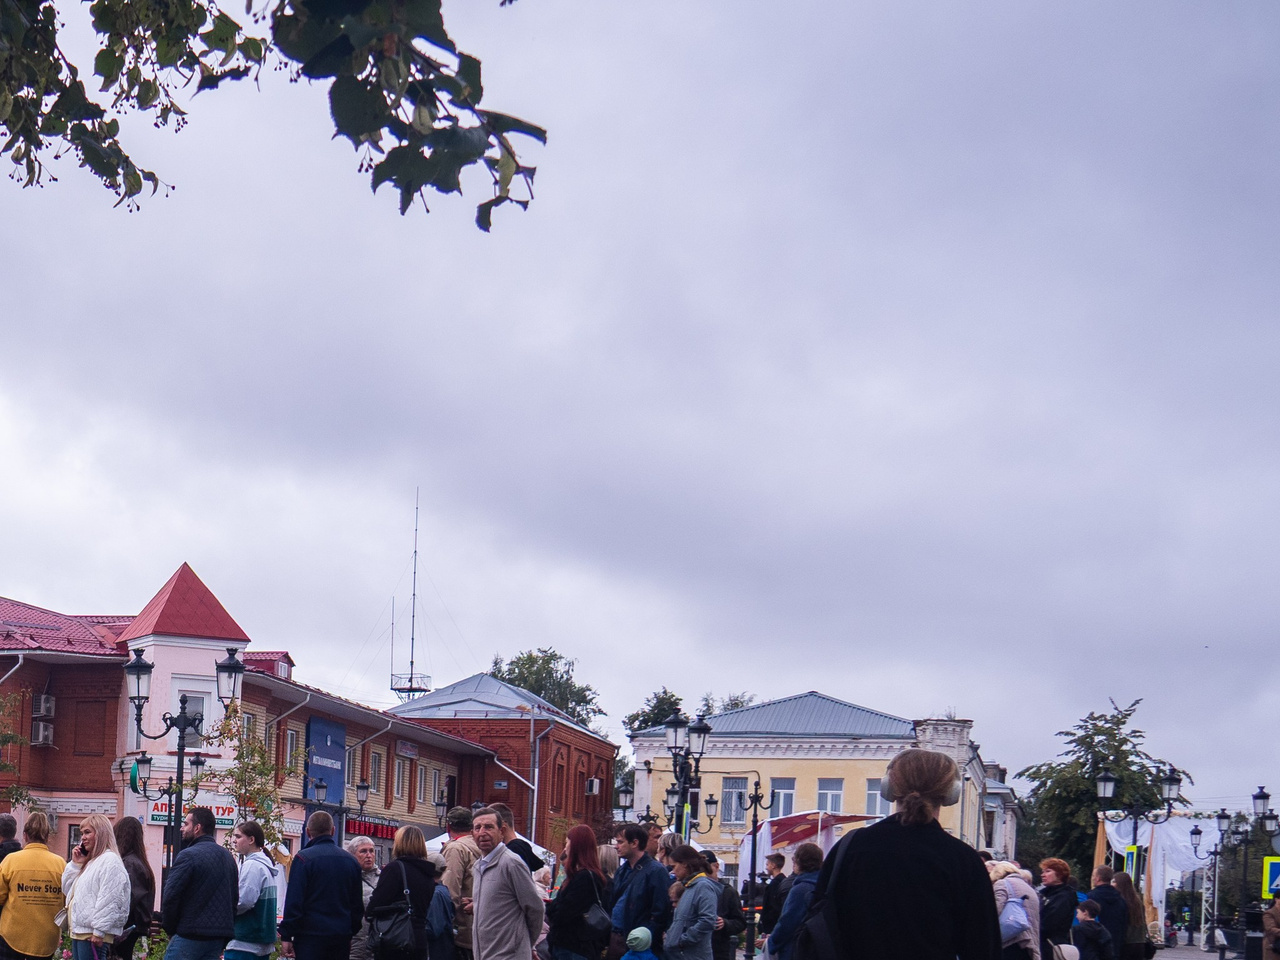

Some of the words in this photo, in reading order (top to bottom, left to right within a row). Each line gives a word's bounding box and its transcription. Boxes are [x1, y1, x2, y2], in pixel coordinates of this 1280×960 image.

[215, 806, 235, 816] ТУР
[17, 882, 42, 893] Never
[44, 884, 62, 895] Stop
